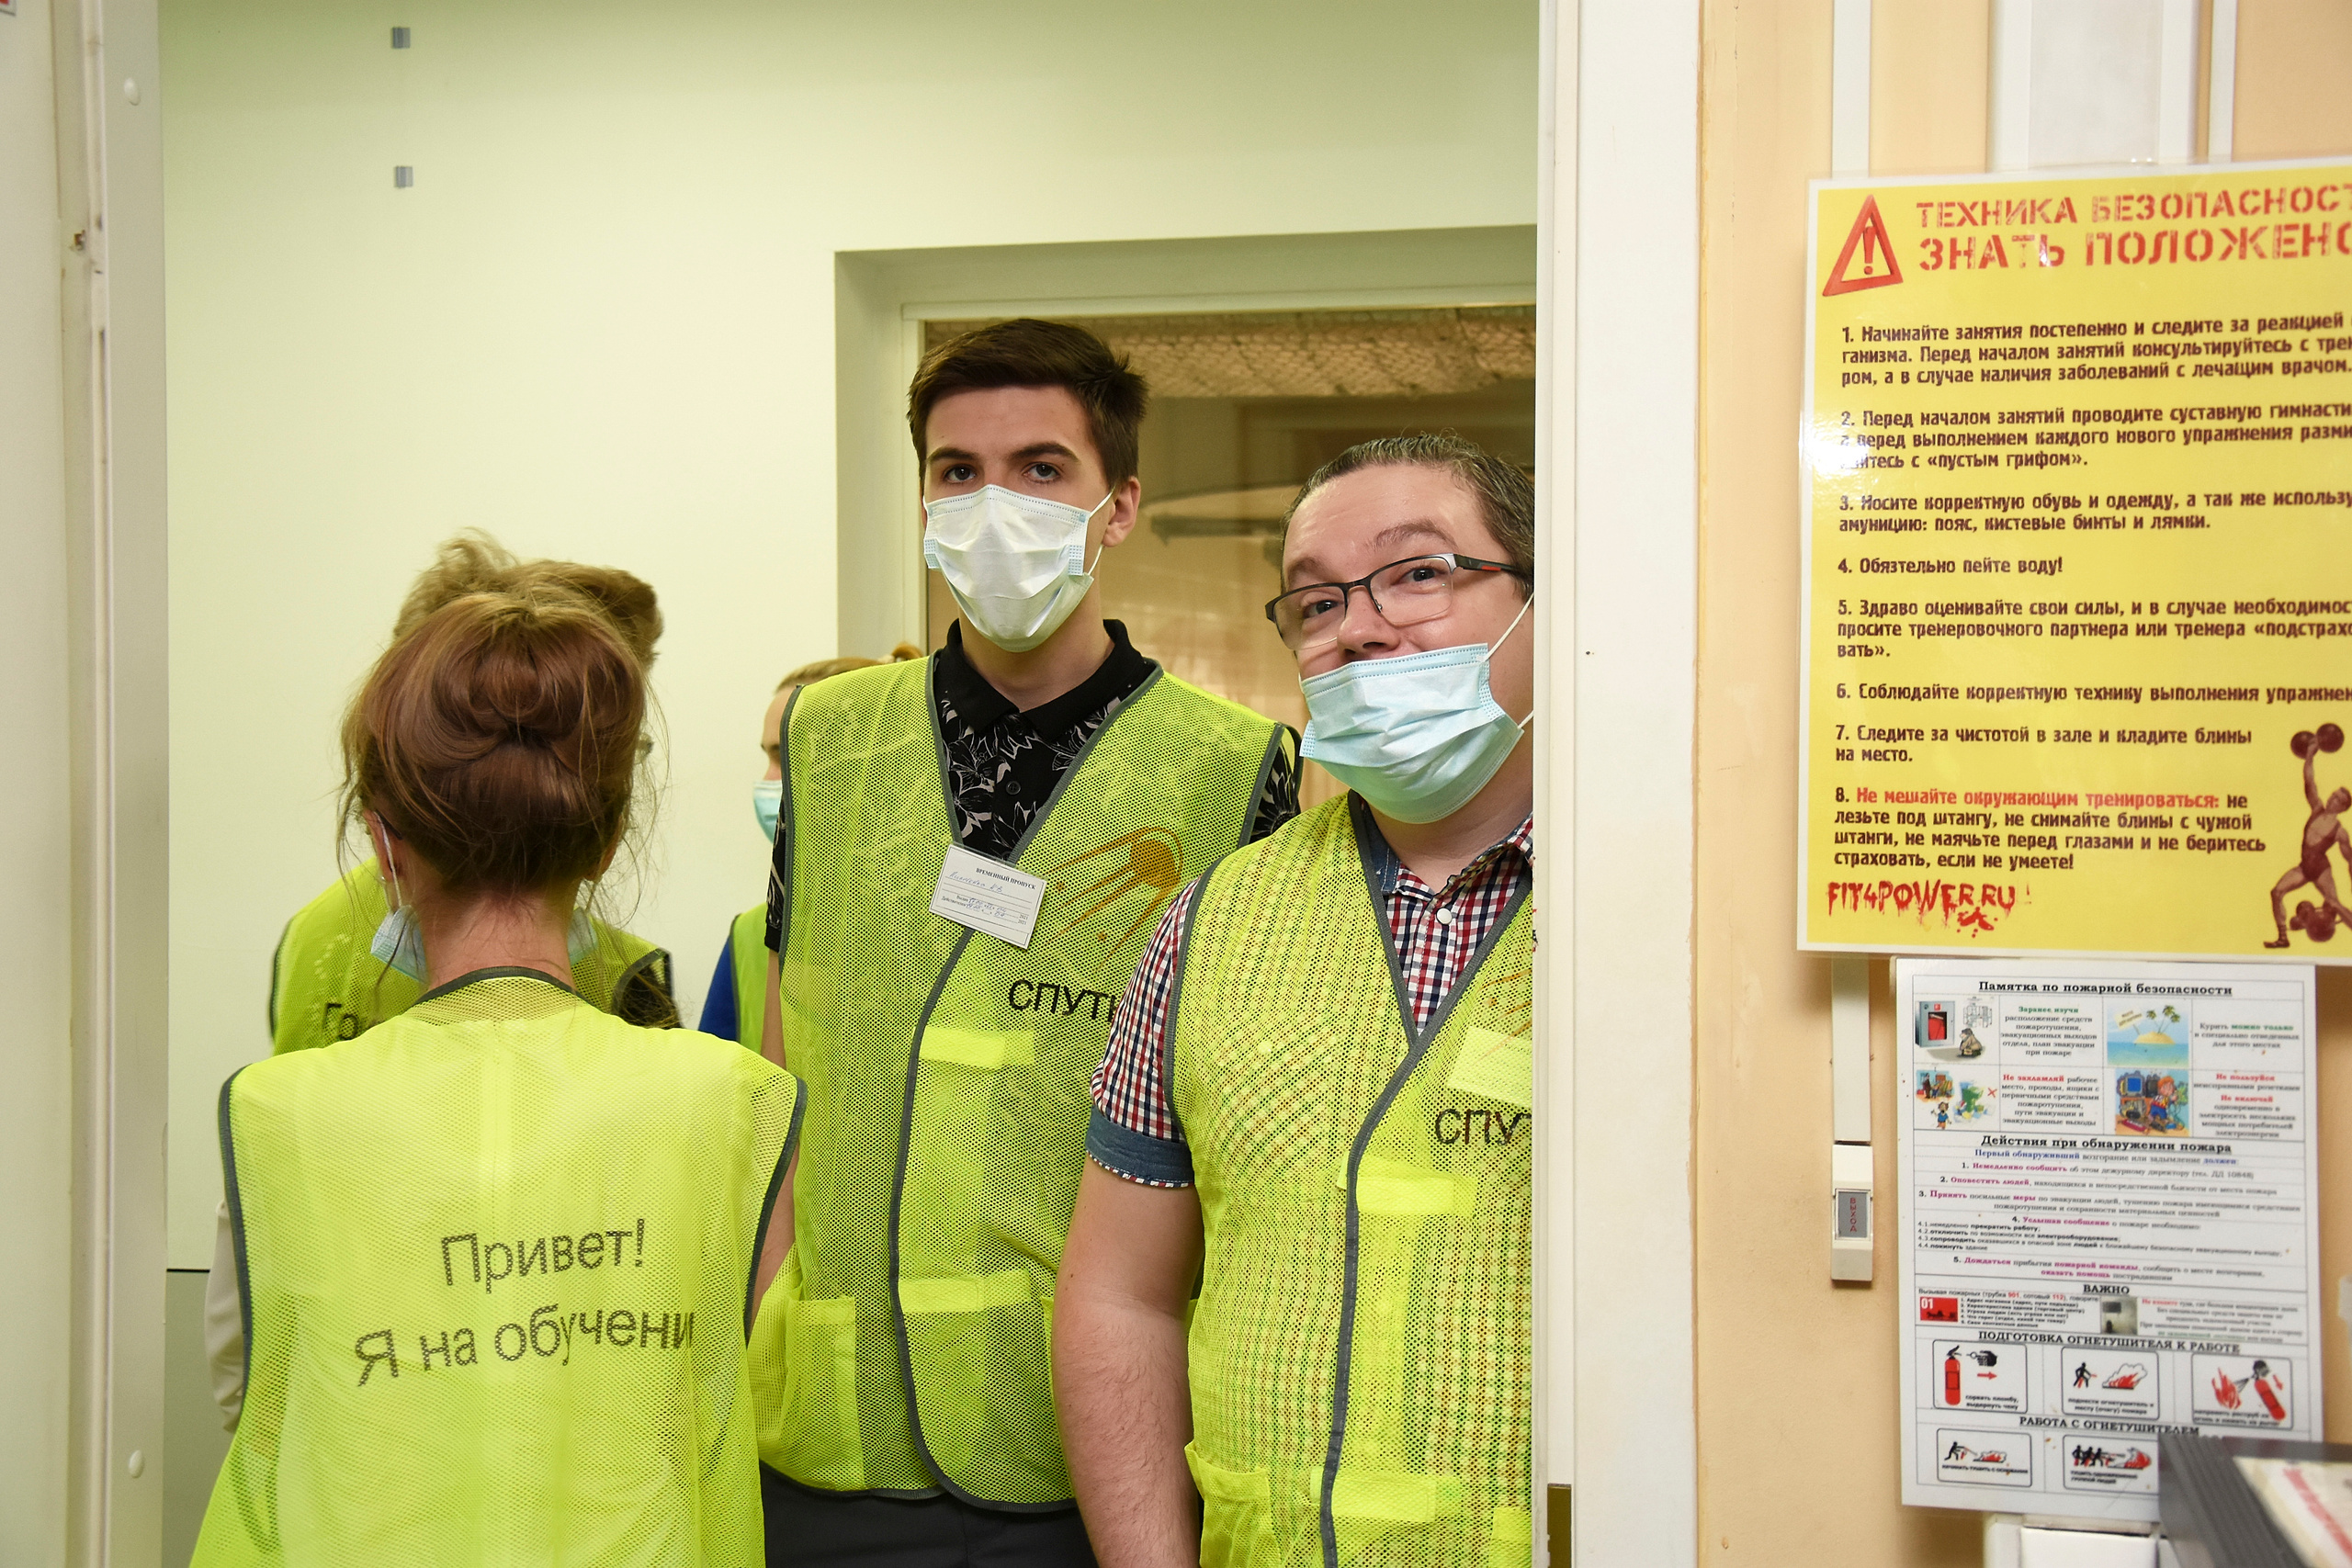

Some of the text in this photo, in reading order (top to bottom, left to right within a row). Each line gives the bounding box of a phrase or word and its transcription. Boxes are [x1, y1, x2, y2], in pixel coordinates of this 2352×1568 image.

[1917, 196, 2078, 229] ТЕХНИКА
[1918, 233, 2066, 272] ЗНАТЬ
[1841, 326, 1855, 344] 1.
[1861, 323, 1950, 343] Начинайте
[1955, 324, 2023, 341] занятия
[2029, 321, 2128, 339] постепенно
[2151, 319, 2224, 337] следите
[2230, 318, 2250, 333] за
[2256, 310, 2345, 335] реакцией
[1841, 349, 1913, 365] ганизма.
[1919, 345, 1973, 366] Перед
[1978, 346, 2050, 362] началом
[2056, 340, 2125, 359] занятий
[2132, 337, 2292, 359] консультируйтесь
[1841, 358, 2352, 389] ром, случае наличия заболеваний лечащим врачом.
[1840, 410, 1856, 427] 2.
[1862, 410, 1915, 430] Перед
[1920, 411, 1991, 427] началом
[1996, 406, 2065, 425] занятий
[2071, 407, 2164, 427] проводите
[2168, 404, 2263, 425] суставную
[1912, 431, 2029, 448] выполнением
[2035, 430, 2109, 447] каждого
[2116, 429, 2177, 445] нового
[2182, 425, 2294, 446] упражнения
[1927, 453, 1999, 472] «пустым
[2006, 449, 2088, 471] грифом».
[1838, 494, 1854, 512] 3.
[1860, 494, 1918, 512] Носите
[1924, 495, 2026, 514] корректную
[2031, 491, 2083, 513] обувь
[2106, 493, 2179, 512] одежду,
[2202, 491, 2233, 508] так
[2239, 491, 2267, 507] же
[1838, 513, 2211, 536] амуницию: пояс, кистевые бинты лямки.
[1837, 557, 1853, 574] 4.
[1962, 556, 2011, 574] пейте
[2017, 555, 2064, 577] воду!
[1837, 599, 1853, 615] 5.
[1859, 599, 1918, 619] Здраво
[1924, 598, 2023, 618] оценивайте
[2029, 601, 2069, 616] свои
[2074, 600, 2125, 617] силы,
[2165, 600, 2227, 619] случае
[1837, 622, 1903, 640] просите
[2050, 622, 2129, 640] партнера
[2134, 622, 2168, 638] или
[2174, 621, 2246, 640] тренера
[1837, 643, 1891, 659] вать».
[1836, 682, 1851, 699] 6.
[1858, 682, 1960, 703] Соблюдайте
[1965, 685, 2068, 705] корректную
[2074, 685, 2143, 705] технику
[2149, 686, 2260, 703] выполнения
[1835, 724, 2253, 747] 7. Следите за чистотой зале кладите блины
[1835, 747, 1914, 762] на место.
[1835, 786, 2248, 811] 8. Не мешайте окружающим тренироваться: не
[1833, 810, 2253, 834] лезьте под штангу, не снимайте блины чужой
[1834, 830, 2267, 855] штанги, не маячьте перед глазами не беритесь
[1833, 852, 2075, 873] страховать, если не умеете!
[1010, 876, 1036, 890] ПРОПУСК
[1979, 981, 2037, 991] Памятка
[2064, 983, 2132, 995] пожарной
[2137, 984, 2232, 995] безопасности
[1974, 1149, 2080, 1160] Первый обнаруживший
[1981, 1135, 2232, 1153] Действия при обнаружении пожара
[441, 1218, 645, 1294] Привет!
[2082, 1284, 2131, 1296] ВАЖНО
[1920, 1297, 1933, 1309] 01
[1979, 1331, 2063, 1344] ПОДГОТОВКА
[2067, 1335, 2172, 1349] ОГНЕТУШИТЕЛЯ
[2177, 1340, 2186, 1349] К
[2190, 1342, 2240, 1353] РАБОТЕ
[355, 1329, 399, 1387] Я
[419, 1327, 478, 1372] на
[2019, 1416, 2068, 1427] РАБОТА
[2072, 1419, 2079, 1428] С
